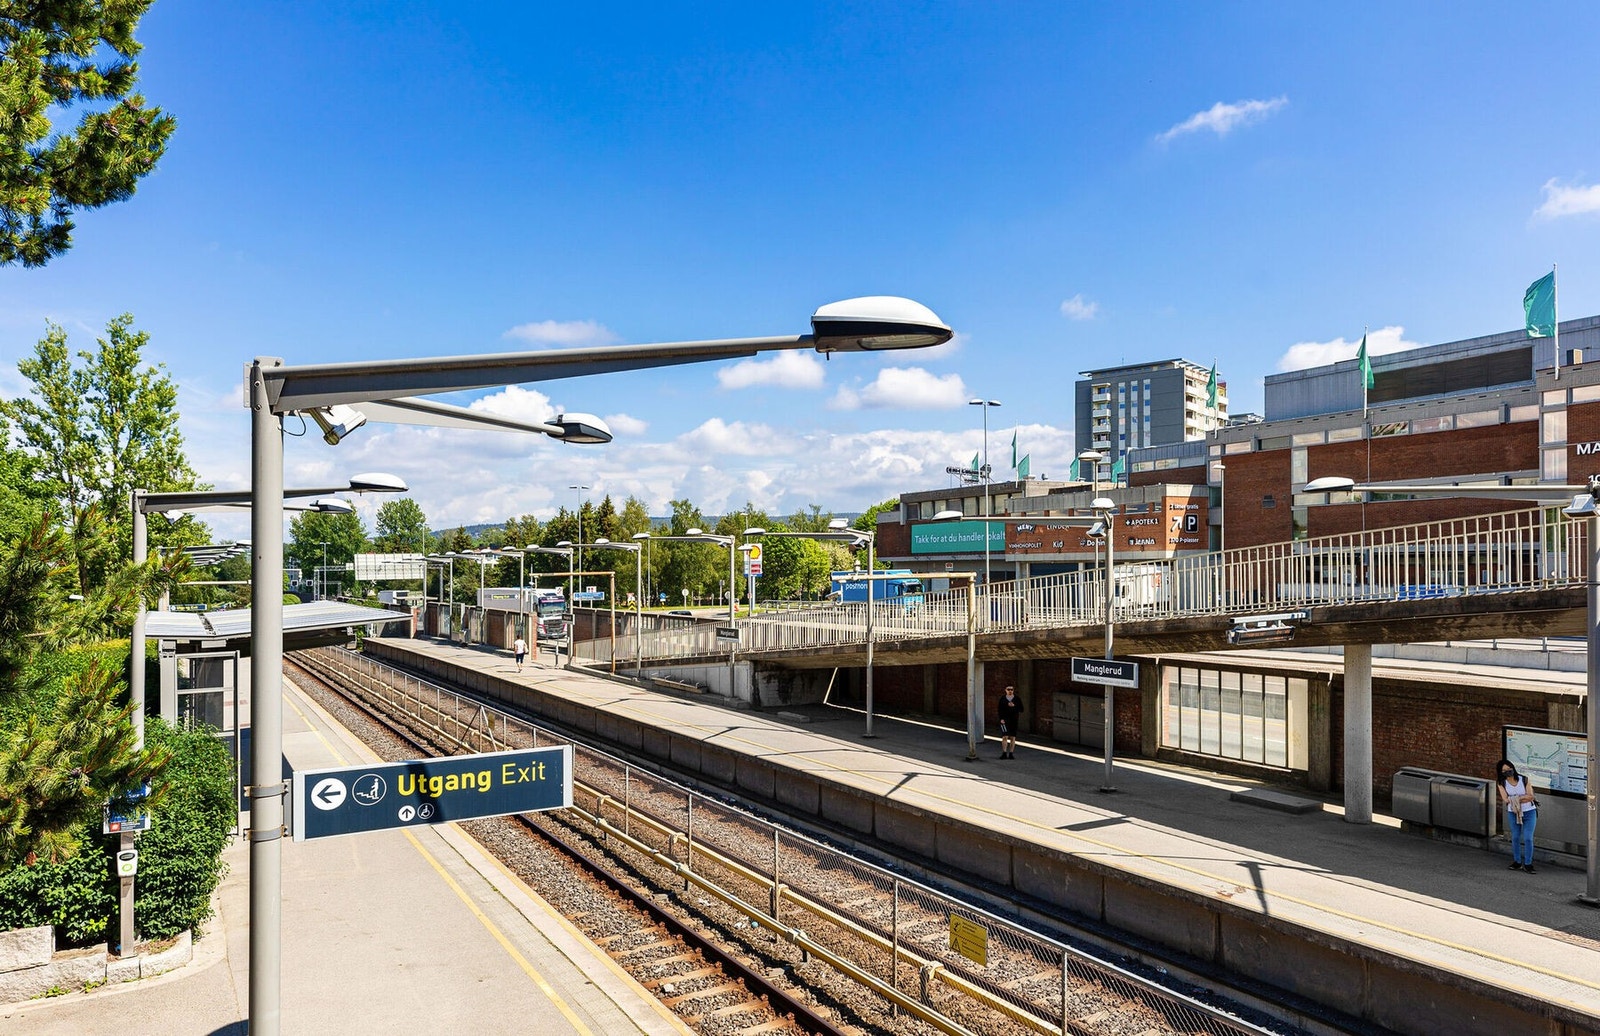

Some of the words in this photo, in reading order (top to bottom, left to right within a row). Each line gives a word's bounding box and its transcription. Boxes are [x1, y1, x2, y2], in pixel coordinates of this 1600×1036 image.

[1576, 442, 1600, 455] MA
[1017, 523, 1034, 531] MENY
[1188, 516, 1196, 530] P
[915, 535, 929, 543] Takk
[930, 534, 940, 543] for
[948, 533, 958, 542] du
[958, 532, 984, 541] handler
[986, 530, 1005, 540] okalt
[1053, 540, 1063, 548] Kid
[1084, 663, 1122, 675] Manglerud
[398, 770, 492, 798] Utgang
[502, 761, 546, 785] Exit
